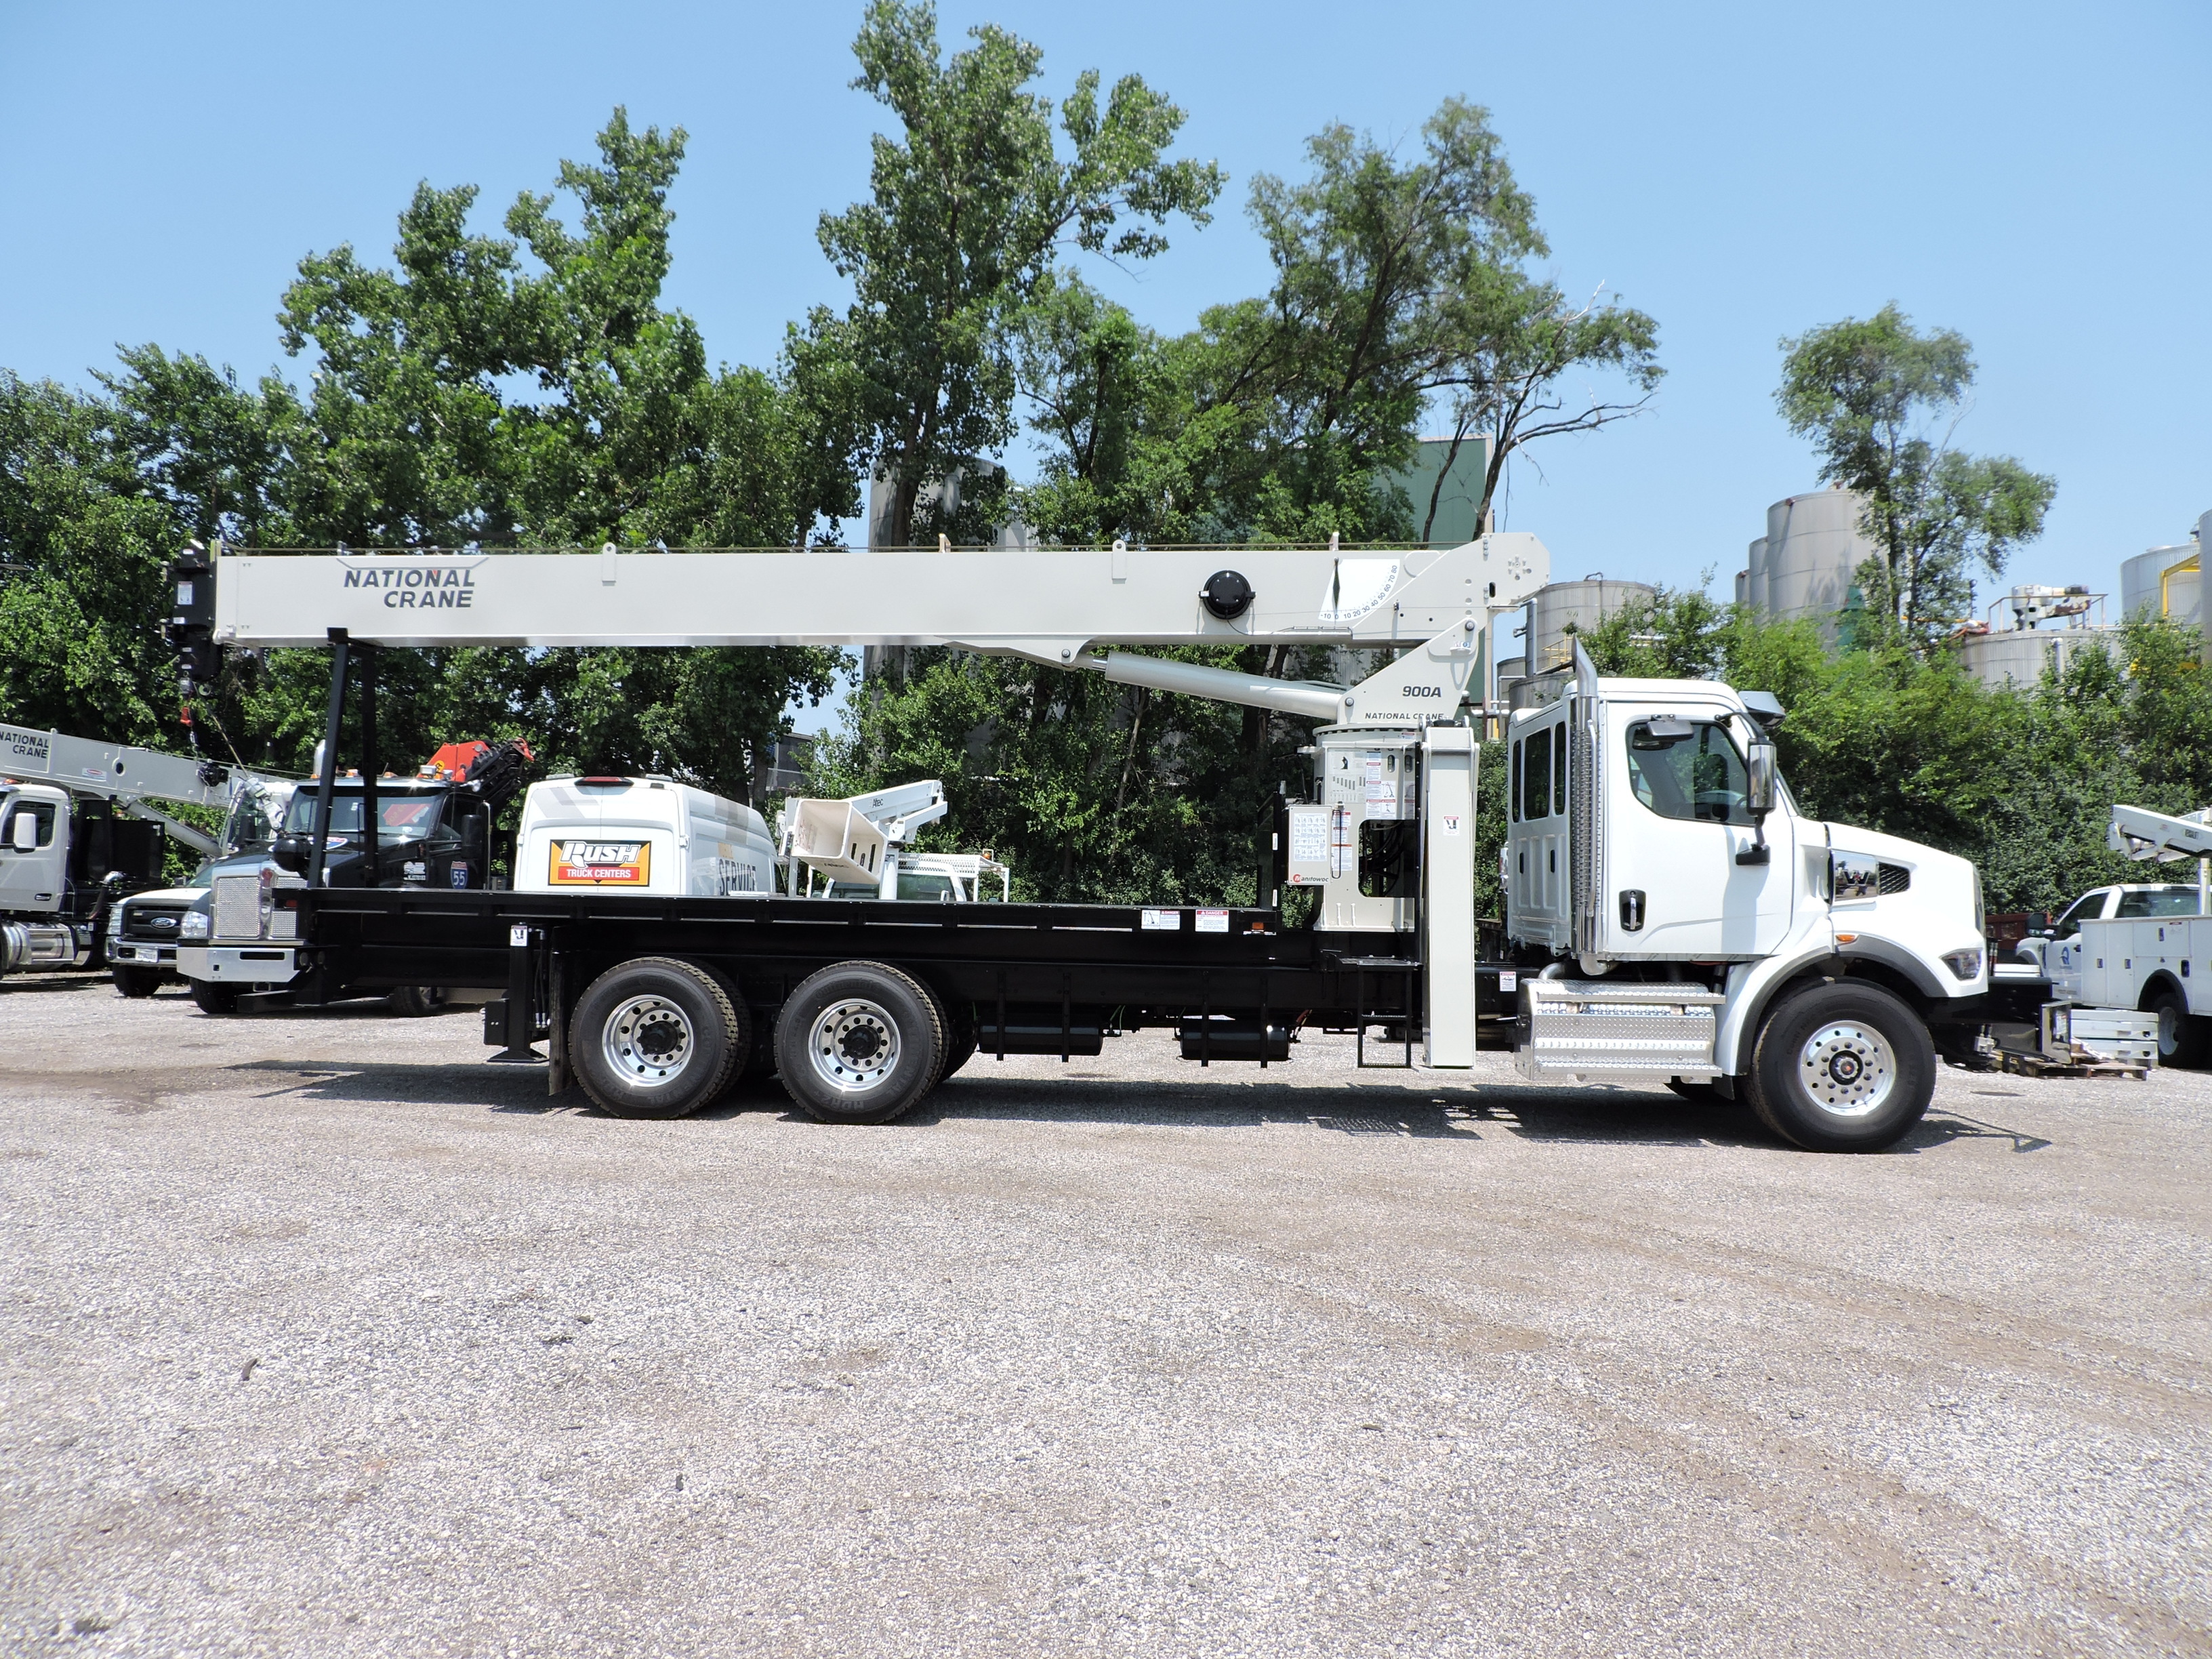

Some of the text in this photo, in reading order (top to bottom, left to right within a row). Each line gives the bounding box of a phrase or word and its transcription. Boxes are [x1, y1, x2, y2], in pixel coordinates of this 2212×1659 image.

[1391, 565, 1398, 574] 80
[344, 569, 475, 588] NATIONAL
[1388, 575, 1395, 583] 70
[1383, 583, 1391, 592] 60
[384, 590, 474, 608] CRANE
[1378, 592, 1386, 600] 50
[1371, 599, 1378, 607] 40
[1361, 605, 1370, 613] 30
[1402, 685, 1441, 697] 900A
[12, 745, 48, 758] CRANE
[872, 798, 884, 808] Altec
[559, 841, 641, 869] RUSH
[567, 869, 631, 878] TRUCK CENTERS
[1293, 874, 1329, 882] Manitowoc
[453, 871, 465, 886] 55
